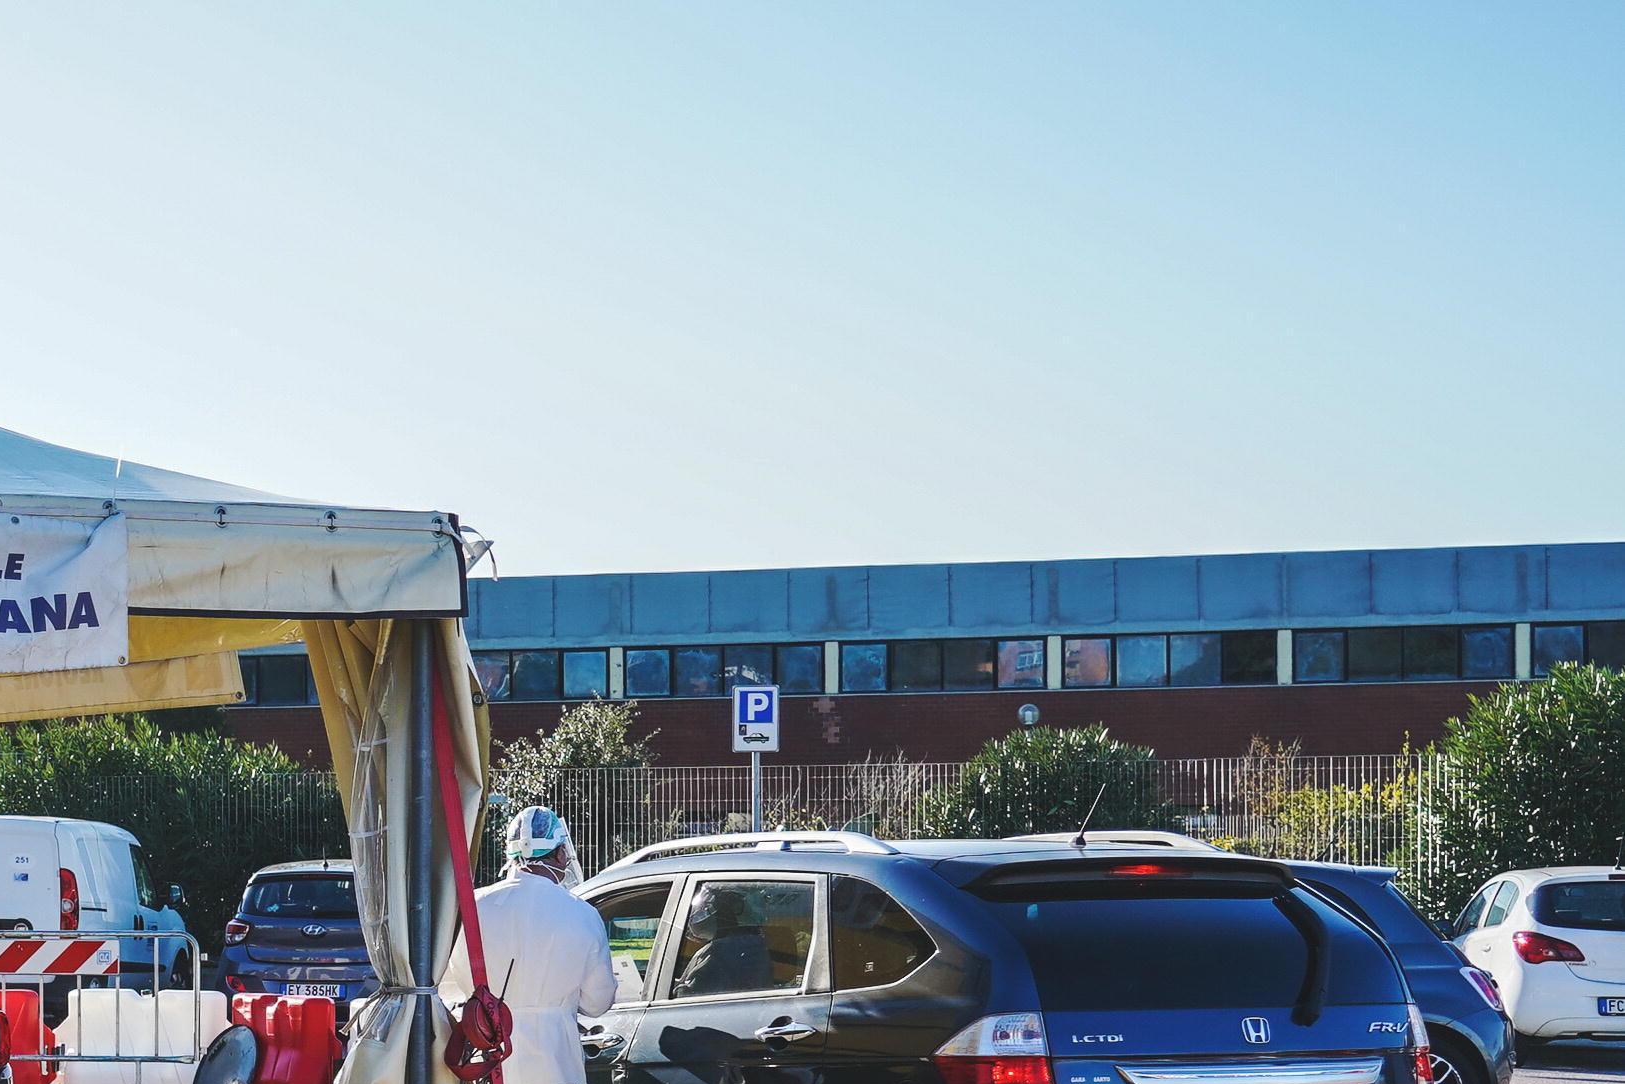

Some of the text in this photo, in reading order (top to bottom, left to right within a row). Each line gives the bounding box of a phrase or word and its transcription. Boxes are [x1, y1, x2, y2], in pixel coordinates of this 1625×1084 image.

[747, 693, 769, 721] P
[15, 856, 29, 864] 251
[288, 985, 300, 996] EY
[305, 985, 338, 996] 385HK
[1608, 1000, 1624, 1012] FC
[1369, 1021, 1408, 1033] FR-V
